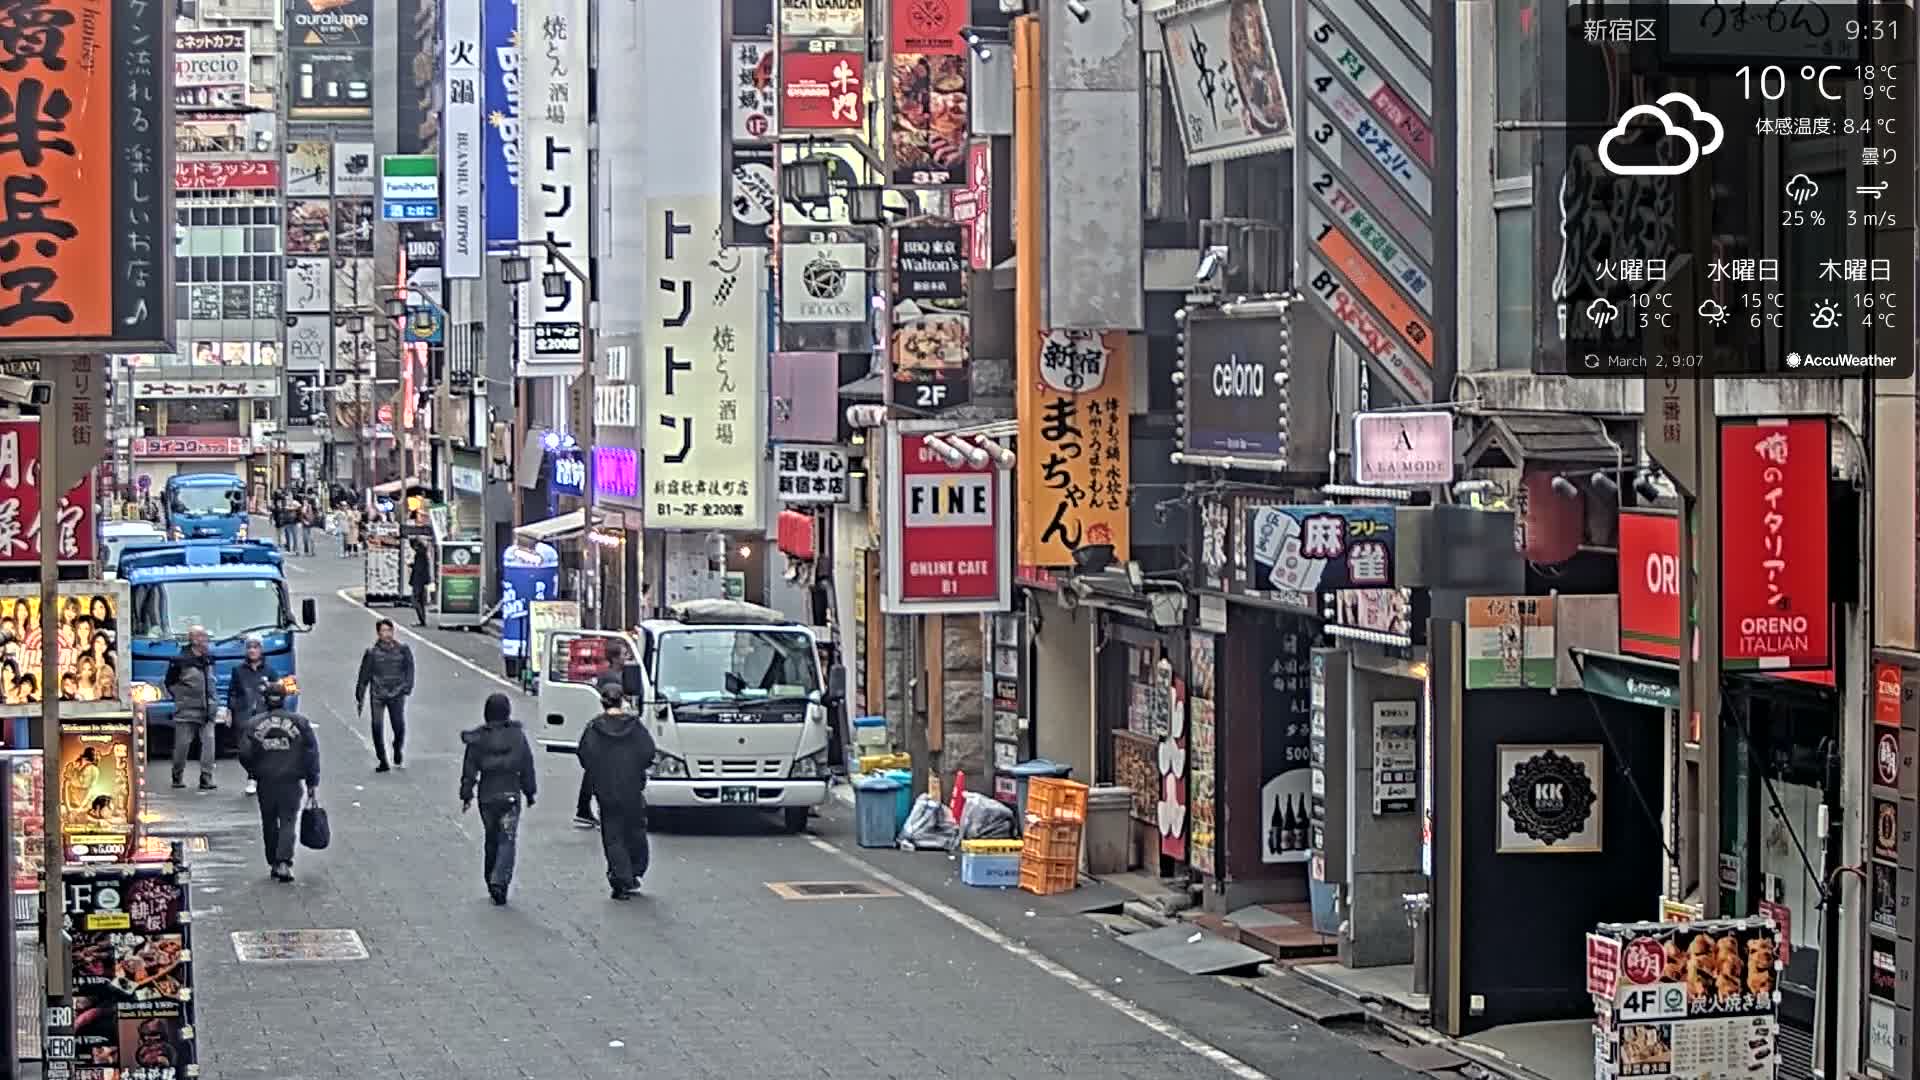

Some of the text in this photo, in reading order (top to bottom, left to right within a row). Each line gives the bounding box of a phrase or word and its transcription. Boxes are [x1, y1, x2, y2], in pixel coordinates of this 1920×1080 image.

[1314, 23, 1335, 43] 5
[450, 39, 475, 105] 火鍋
[543, 15, 569, 124] 焼とん酒場
[1314, 76, 1334, 93] 4
[1314, 124, 1334, 143] 3
[1355, 119, 1412, 181] センチュリー
[386, 182, 436, 193] FamilyMart
[1313, 174, 1333, 195] 2
[456, 204, 468, 256] HOTPOT
[1317, 224, 1333, 242] 1
[900, 256, 960, 272] Walton's
[1312, 270, 1341, 300] B1
[660, 210, 692, 463] トントン
[1044, 340, 1103, 376] 新宿
[712, 325, 737, 445] 焼とん酒場
[1212, 354, 1265, 397] celona
[917, 385, 946, 405] 2F
[1393, 424, 1413, 450] A
[778, 450, 843, 473] 酒場心
[1402, 460, 1446, 473] MODE
[1040, 397, 1086, 550] まっちゃん
[653, 479, 749, 496] 新宿歌舞伎町店
[778, 475, 843, 494] 新宿本店
[702, 502, 744, 516] 全200席
[911, 486, 986, 515] FINE
[1349, 520, 1389, 536] フリー
[1755, 432, 1790, 606] 俺のイタリアン
[910, 560, 989, 576] ONLINE CAFE
[1646, 554, 1680, 593] OR
[941, 580, 958, 595] B1
[1740, 617, 1808, 636] ORENO
[1739, 635, 1809, 654] ITALIAN
[1535, 783, 1564, 801] KK
[1623, 990, 1657, 1013] 4F
[1691, 992, 1771, 1014] 炭火焼き鳥
